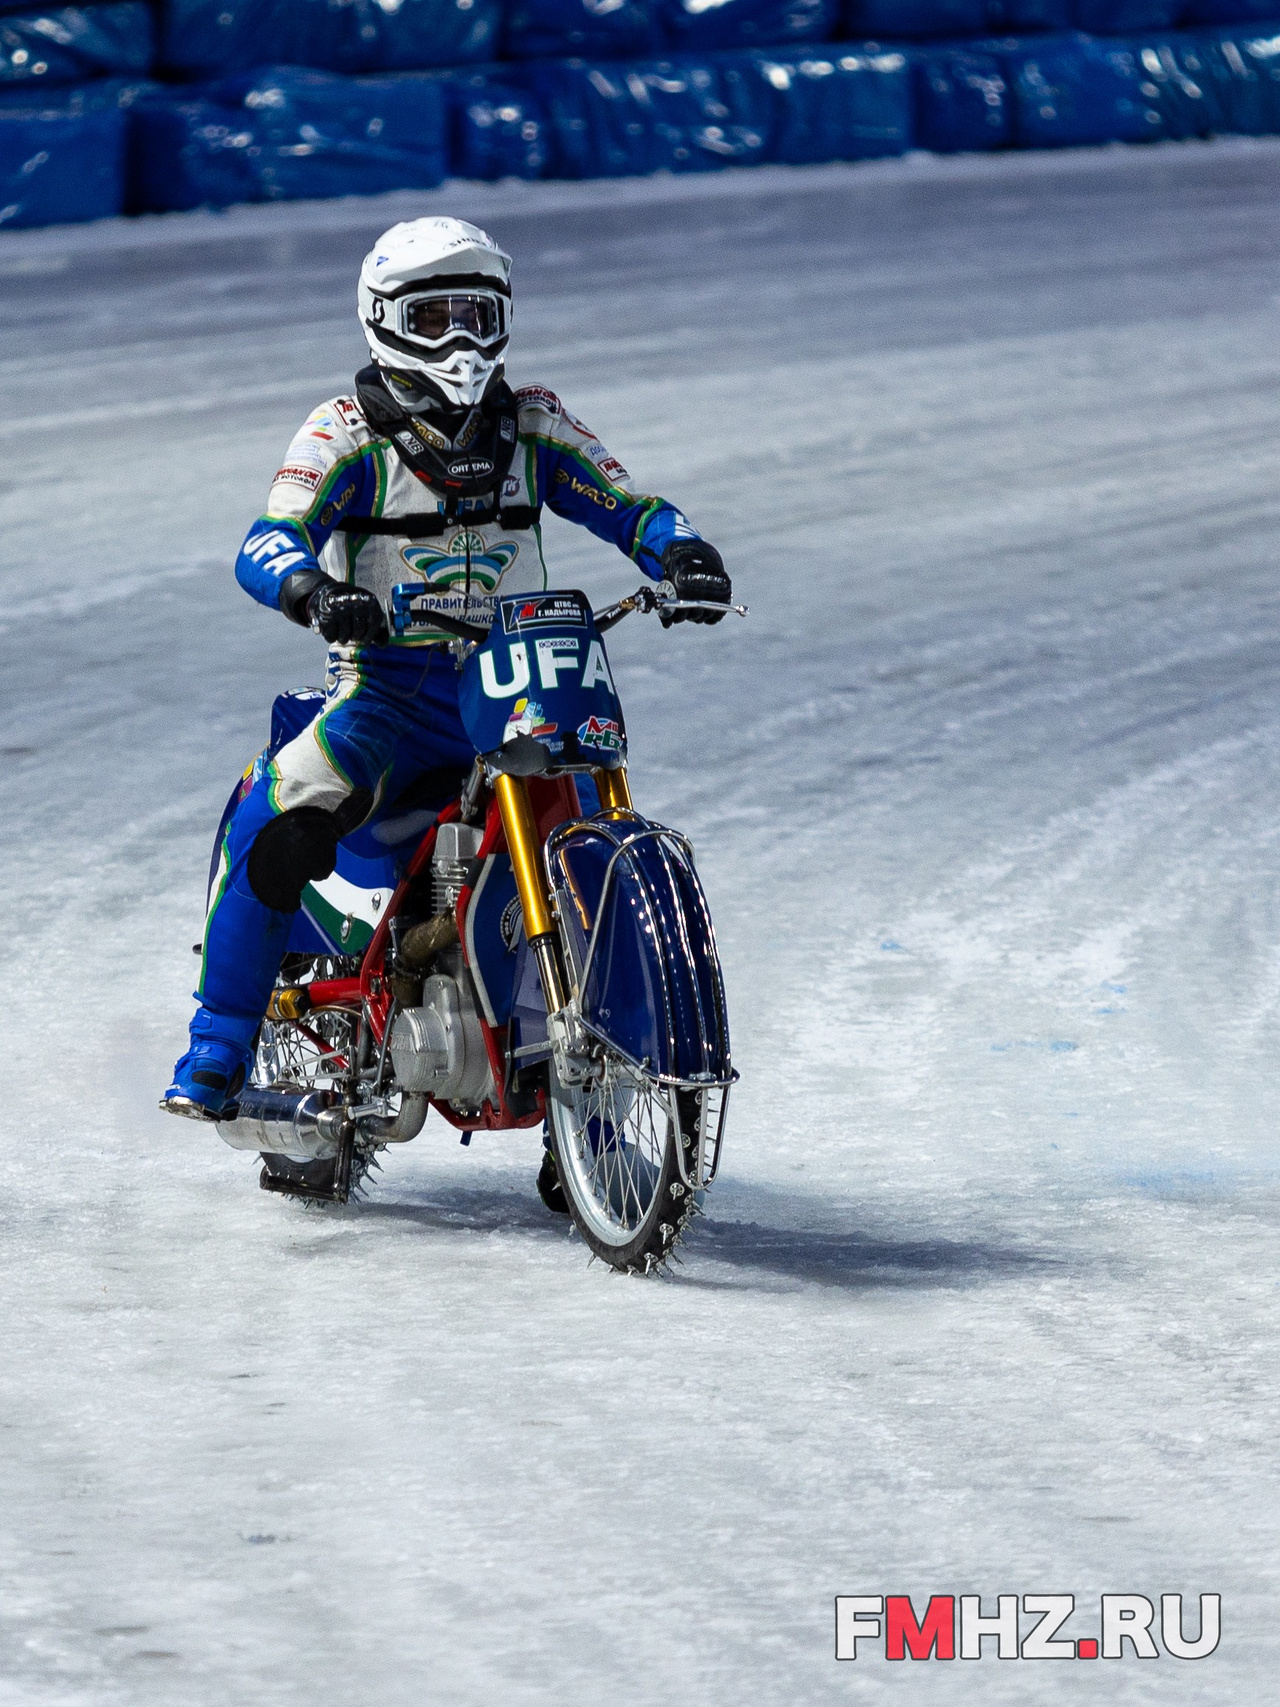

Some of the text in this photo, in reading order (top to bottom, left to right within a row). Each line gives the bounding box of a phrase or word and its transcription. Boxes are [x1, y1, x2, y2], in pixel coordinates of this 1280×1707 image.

[413, 420, 444, 449] ACO
[451, 462, 491, 474] ORTEMA
[571, 477, 617, 510] WACO
[243, 530, 307, 577] UFA
[479, 637, 615, 699] UFA
